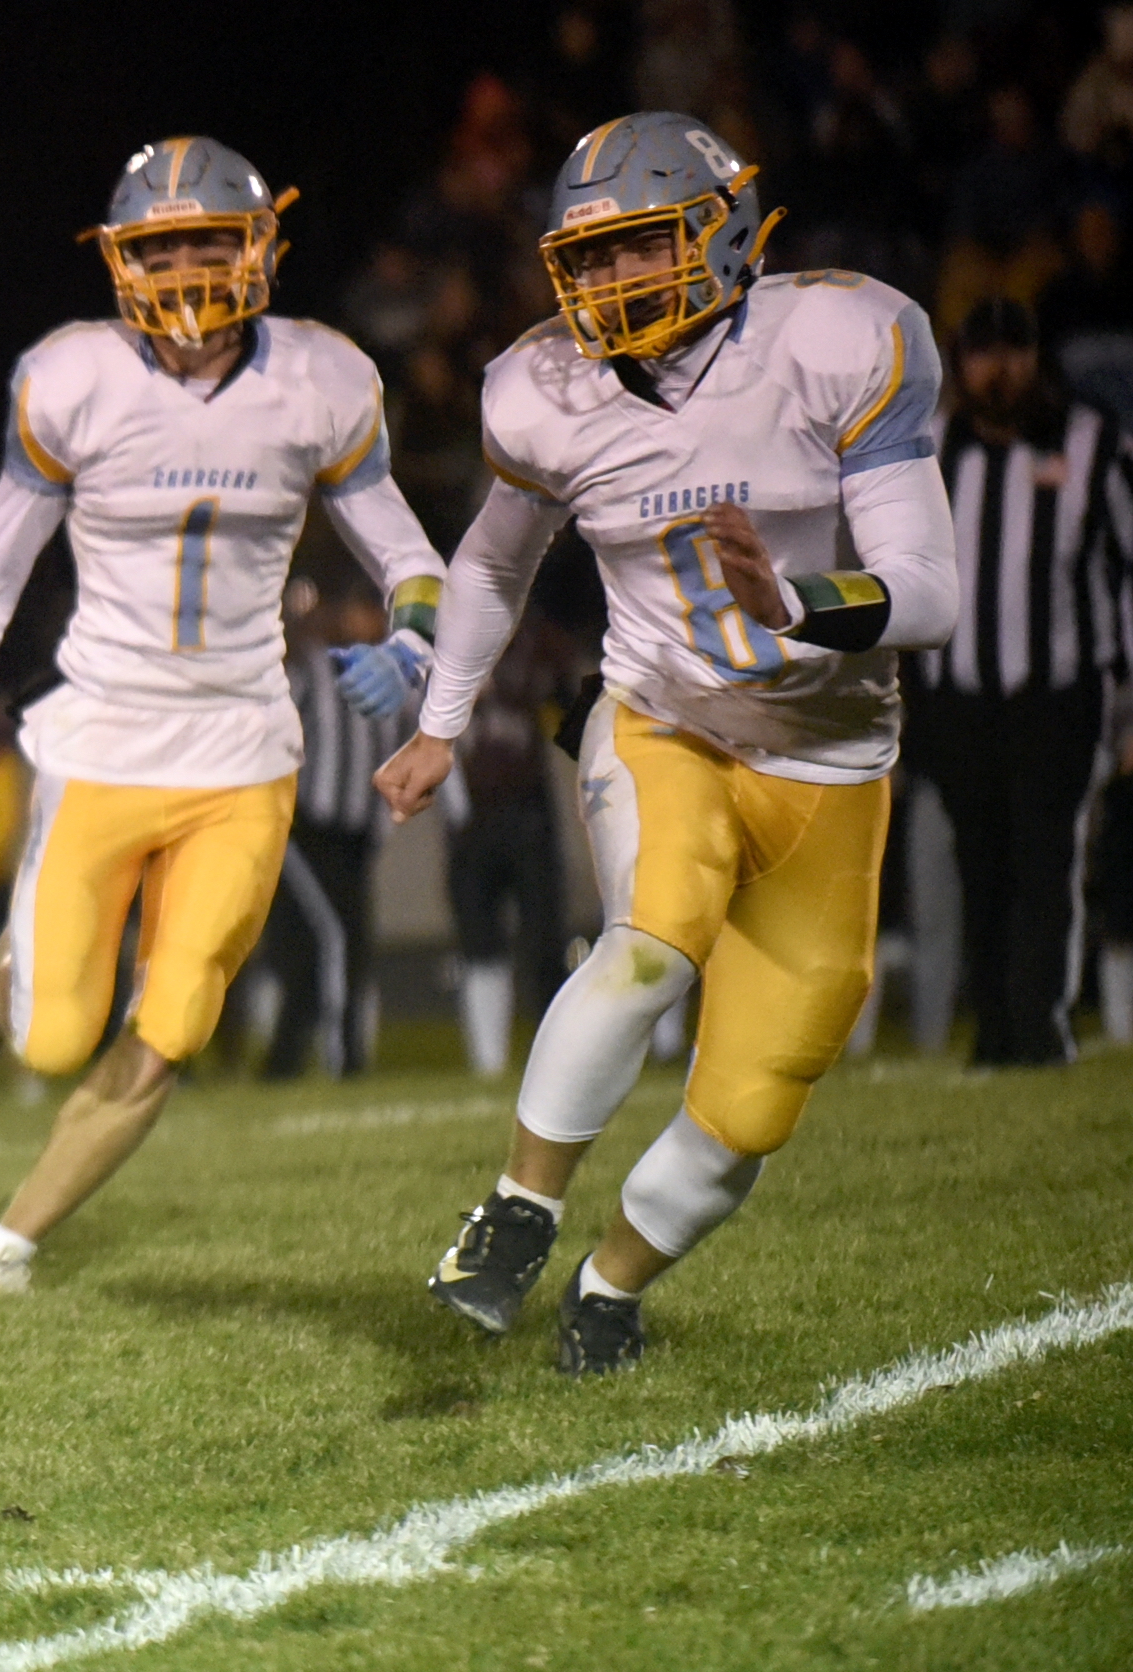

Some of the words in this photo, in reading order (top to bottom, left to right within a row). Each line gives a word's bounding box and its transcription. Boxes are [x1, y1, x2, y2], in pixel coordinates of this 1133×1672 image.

[684, 129, 734, 179] 8
[152, 466, 258, 489] CHARGERS
[639, 480, 750, 519] CHARGERS
[171, 495, 220, 654] 1
